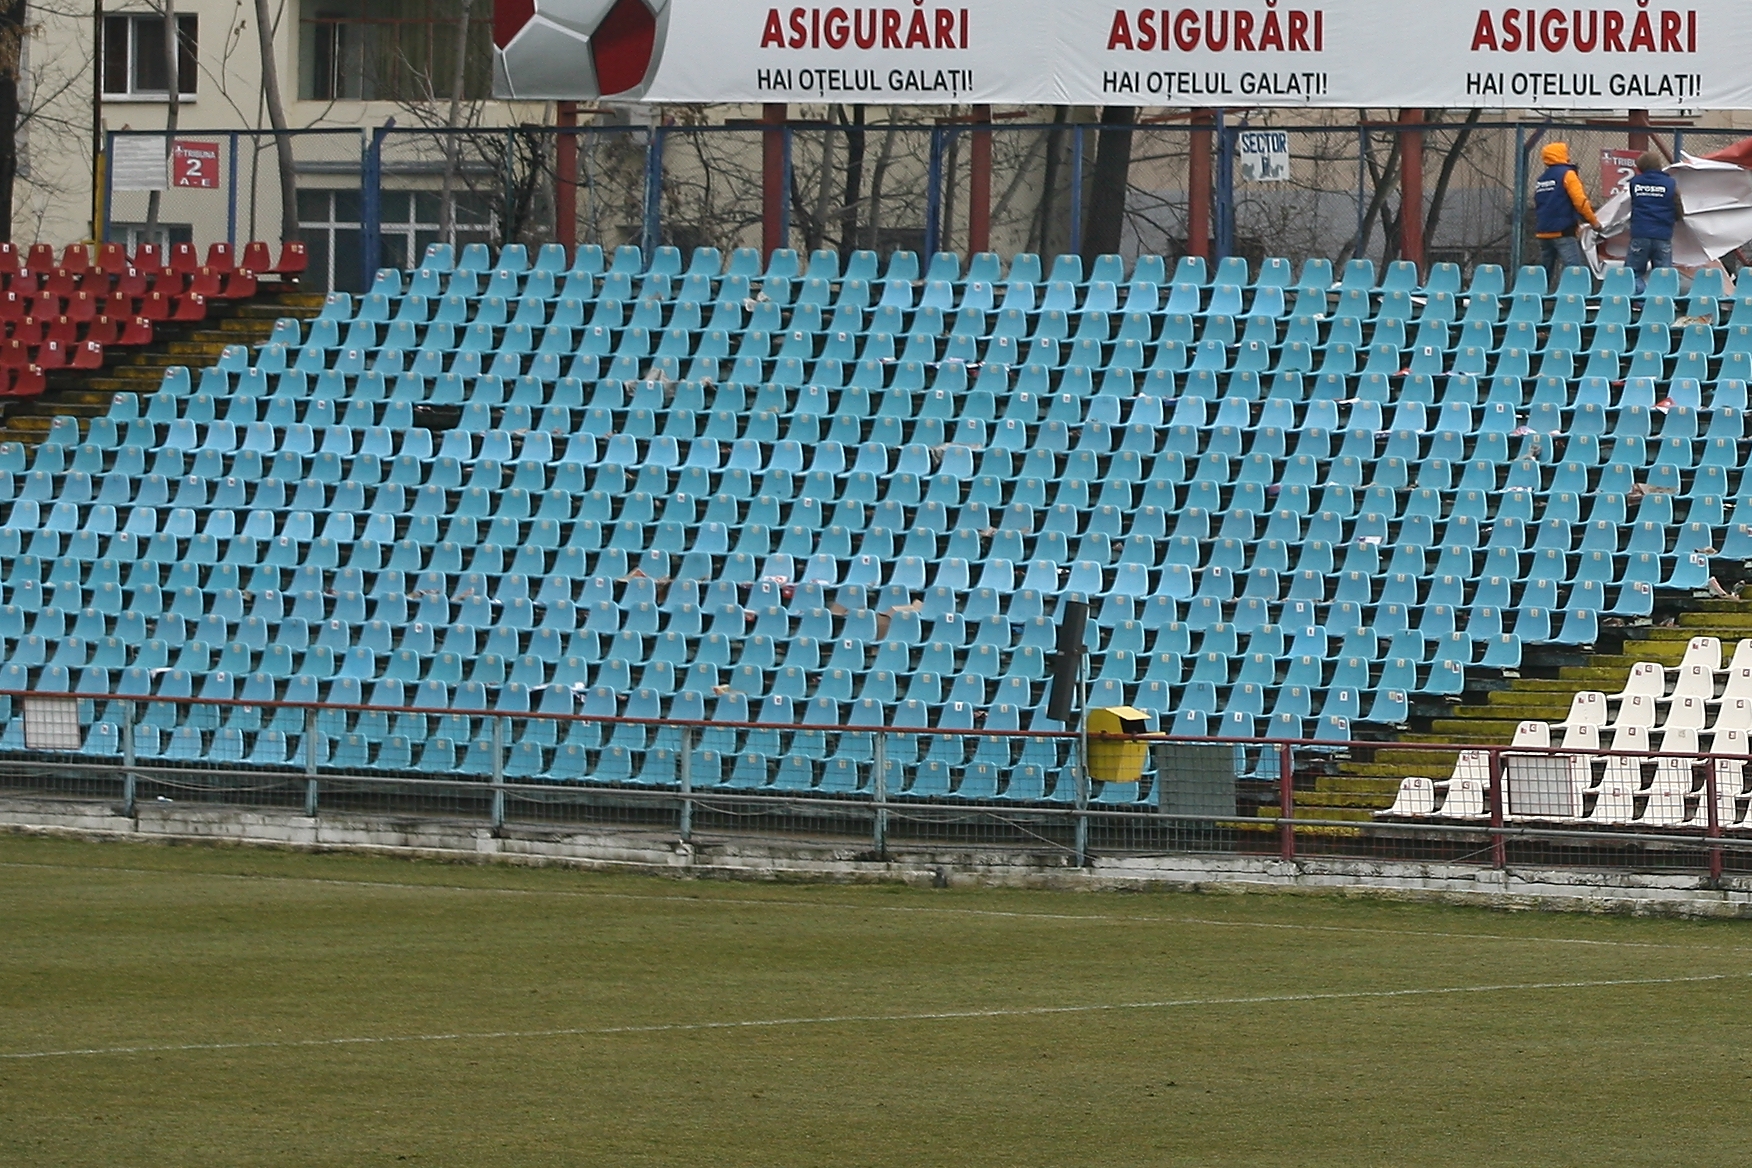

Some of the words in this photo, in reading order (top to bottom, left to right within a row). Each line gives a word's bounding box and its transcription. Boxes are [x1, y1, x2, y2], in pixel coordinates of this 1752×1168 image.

[763, 0, 968, 49] ASIGURĂRI
[1109, 0, 1322, 51] ASIGURĂRI
[1472, 0, 1696, 53] ASIGURĂRI
[757, 68, 792, 91] HAI
[888, 69, 973, 98] GALAȚI!
[1103, 71, 1139, 93] HAI
[1240, 72, 1327, 102] GALAȚI!
[1466, 72, 1504, 95] HAI
[1609, 73, 1701, 104] GALAȚI!
[1241, 132, 1287, 153] SECTOR
[179, 177, 190, 186] A
[185, 157, 203, 177] 2
[1617, 166, 1636, 187] 2
